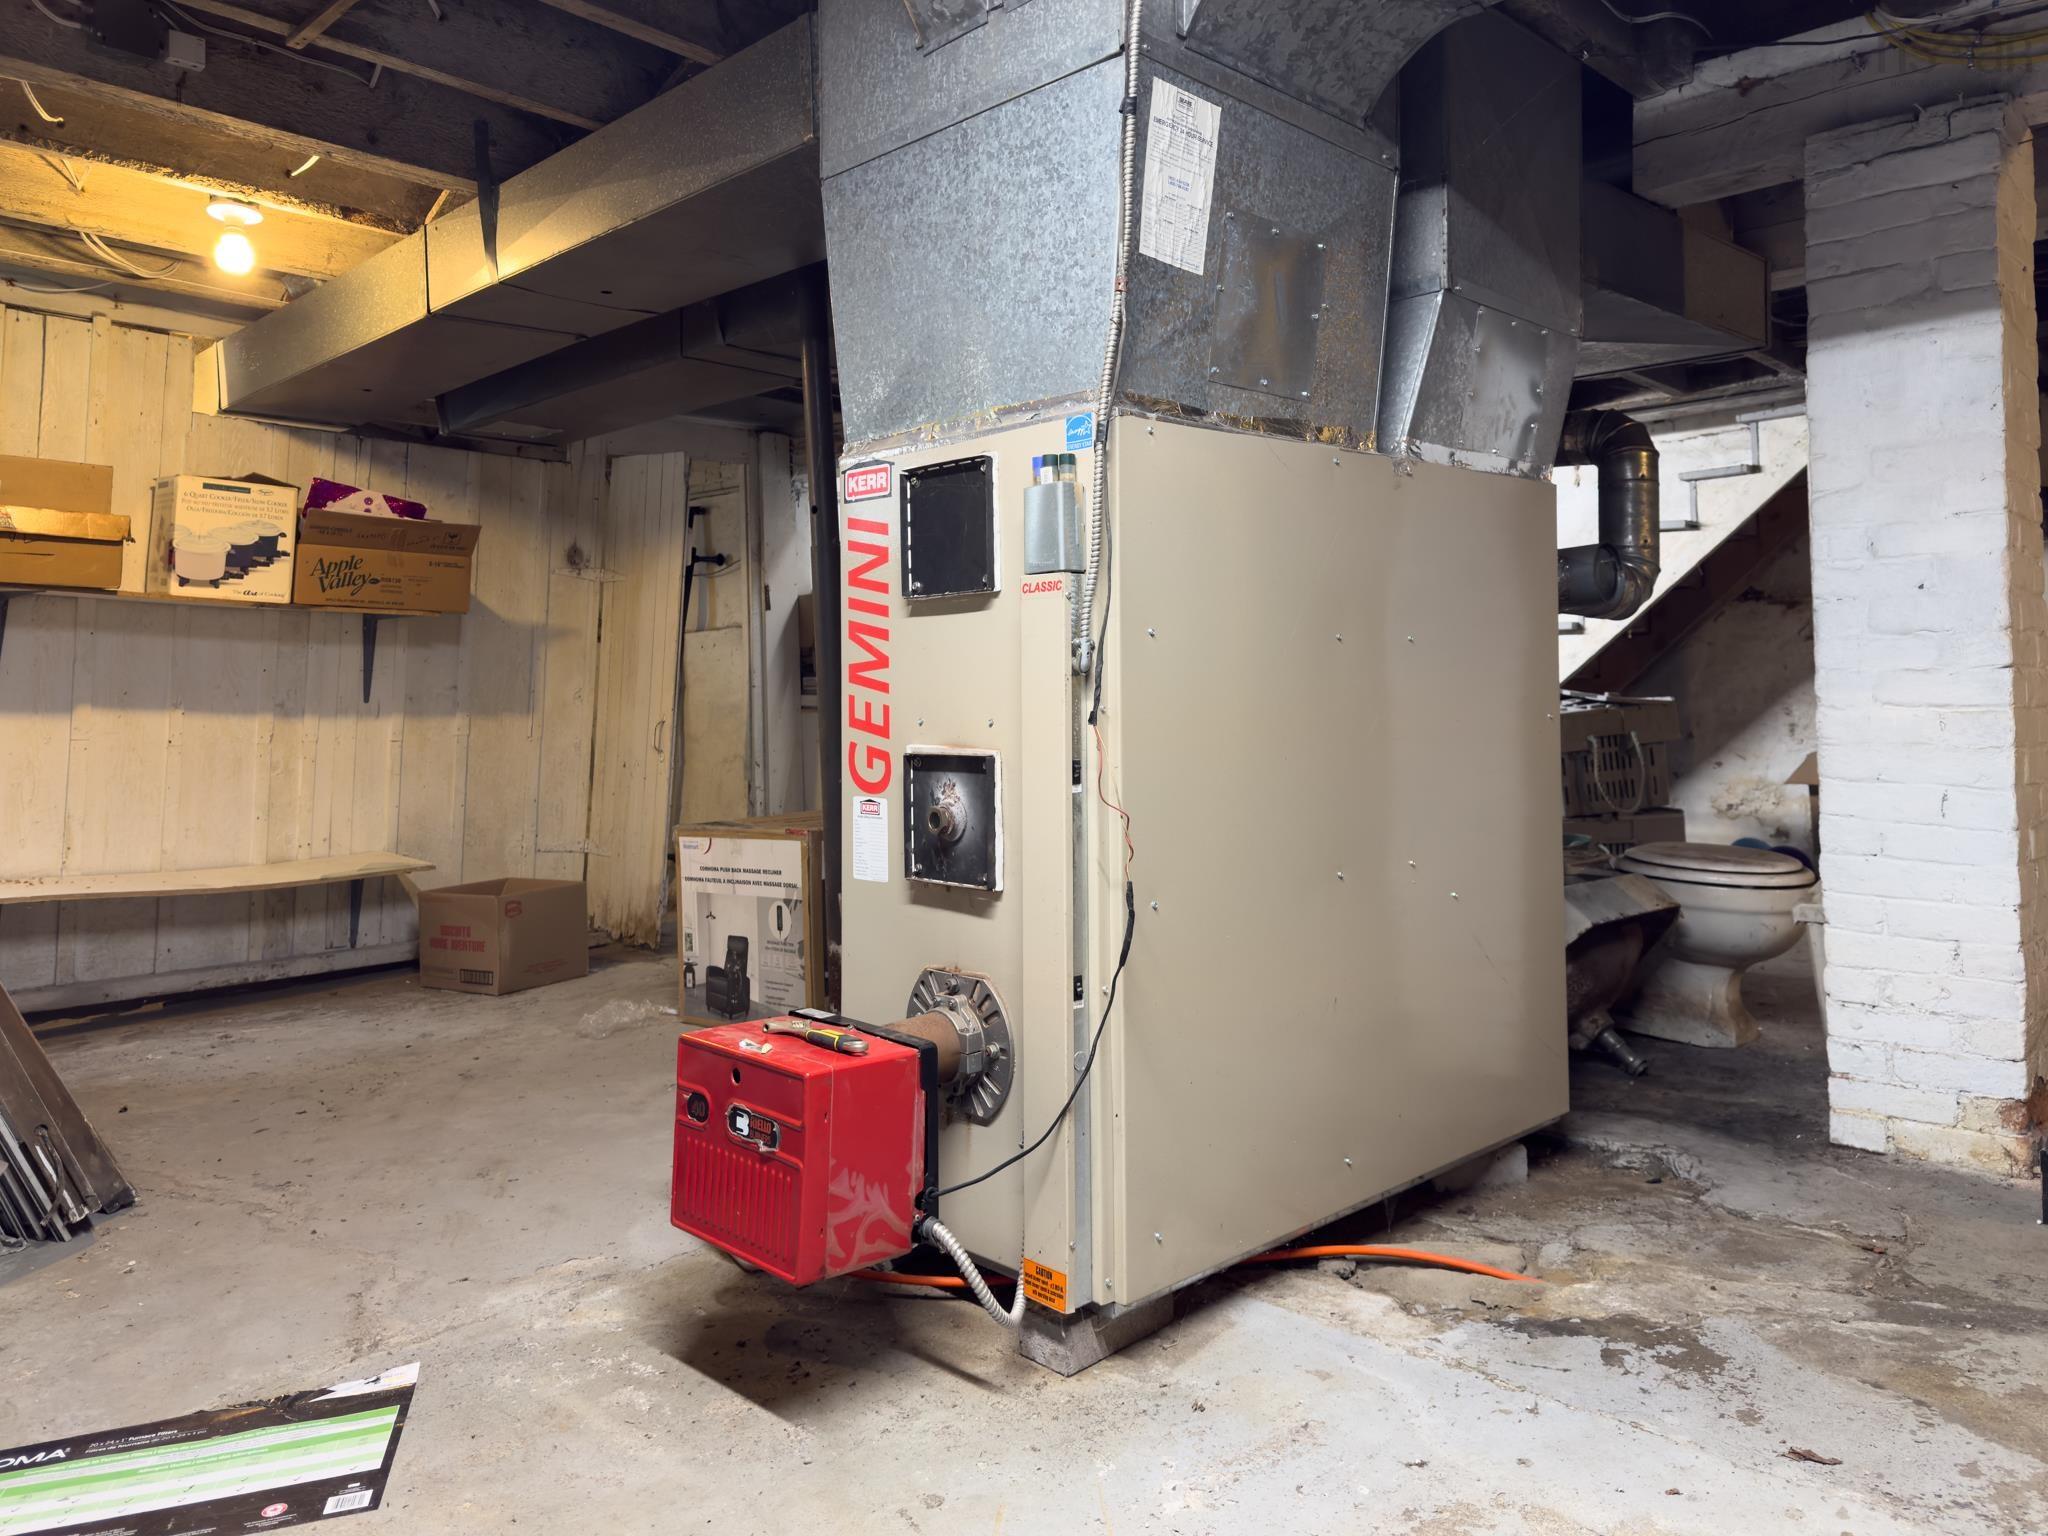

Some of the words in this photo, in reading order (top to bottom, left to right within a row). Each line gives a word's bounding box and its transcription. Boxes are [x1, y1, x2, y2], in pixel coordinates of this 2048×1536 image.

[848, 472, 887, 493] KERR
[310, 555, 364, 577] Apple
[318, 572, 372, 596] Valley
[1022, 580, 1062, 594] CLASSIC
[847, 517, 892, 795] GEMINI
[862, 804, 878, 812] KERR
[750, 1116, 772, 1134] RIELLO
[1035, 1266, 1052, 1280] CAUTION
